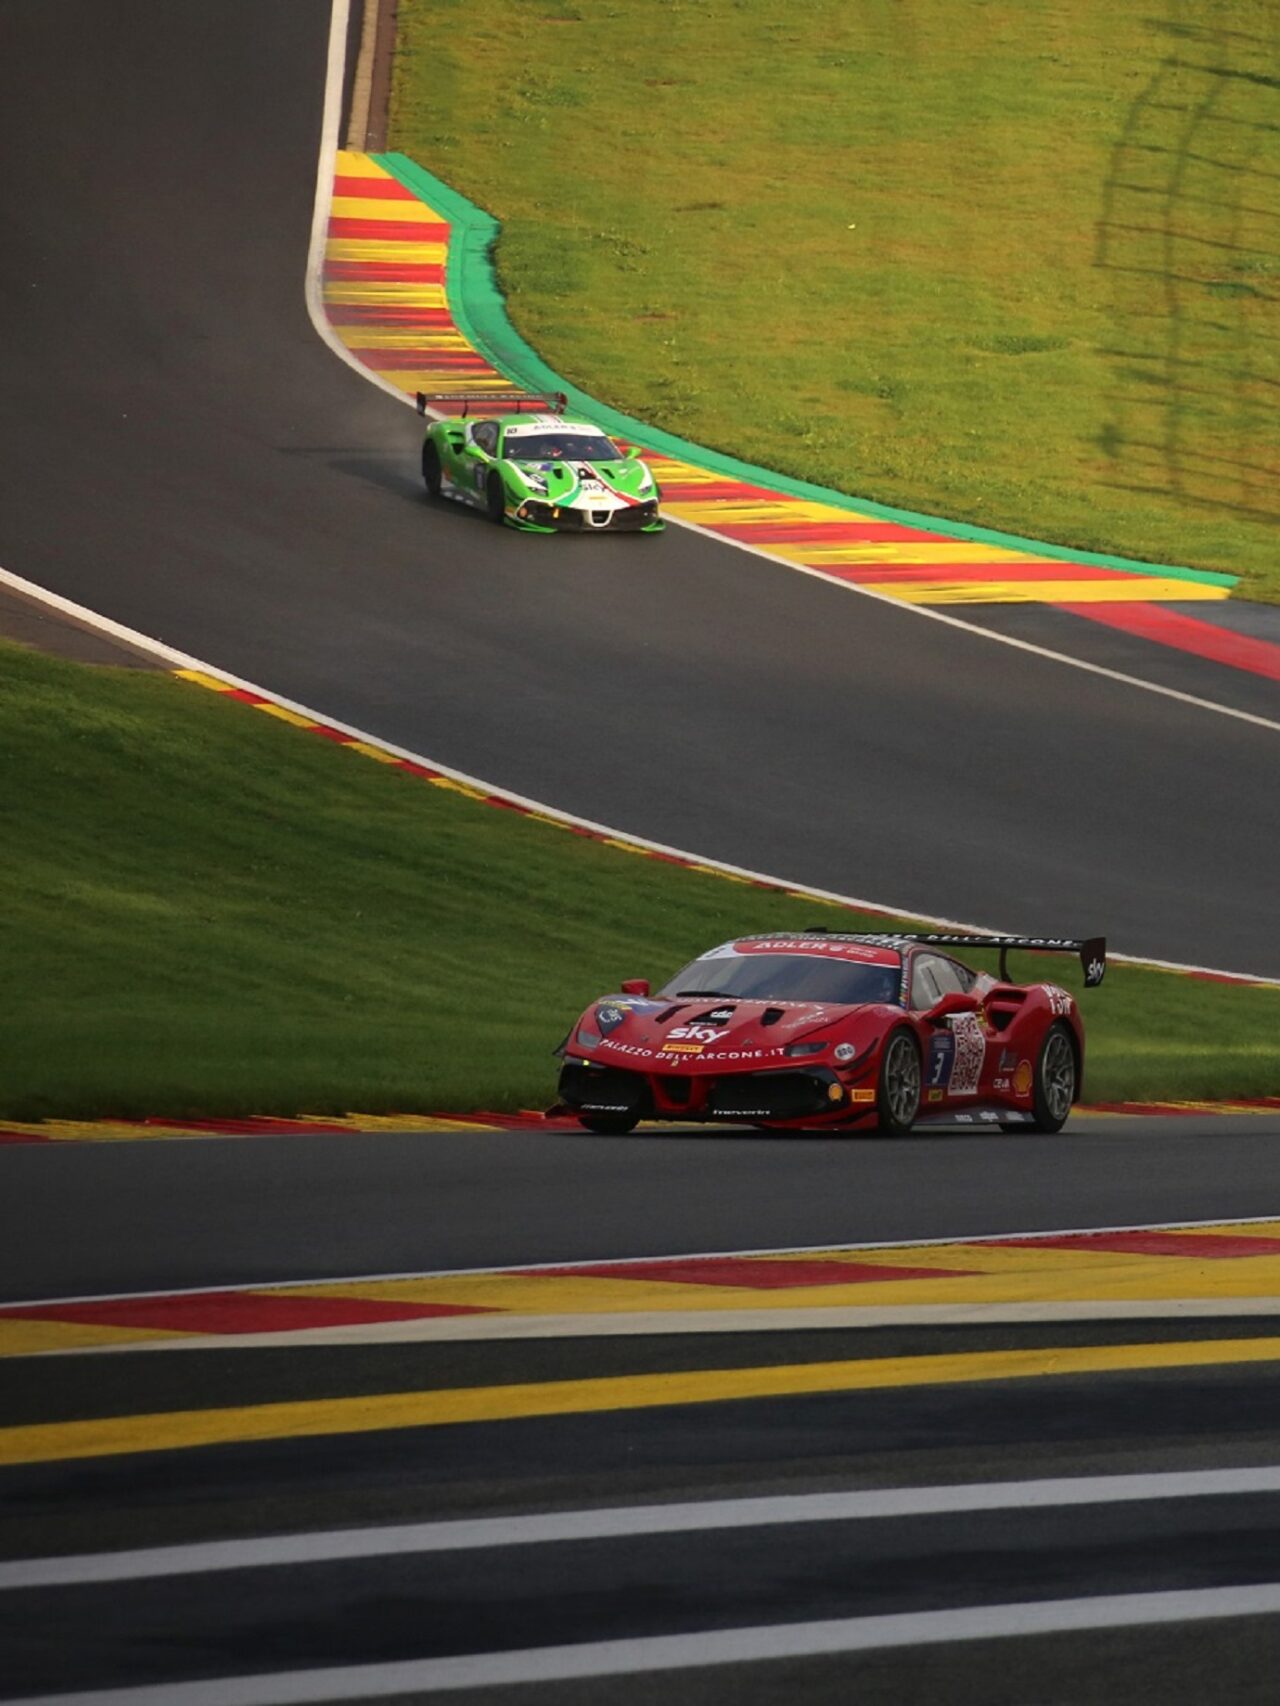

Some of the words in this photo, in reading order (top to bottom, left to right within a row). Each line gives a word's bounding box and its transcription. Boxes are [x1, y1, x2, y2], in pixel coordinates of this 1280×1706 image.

[753, 941, 828, 950] ADLER
[1087, 958, 1105, 983] sky
[666, 1025, 730, 1043] sky
[599, 1039, 653, 1056] PALAZZO
[932, 1052, 944, 1083] 3
